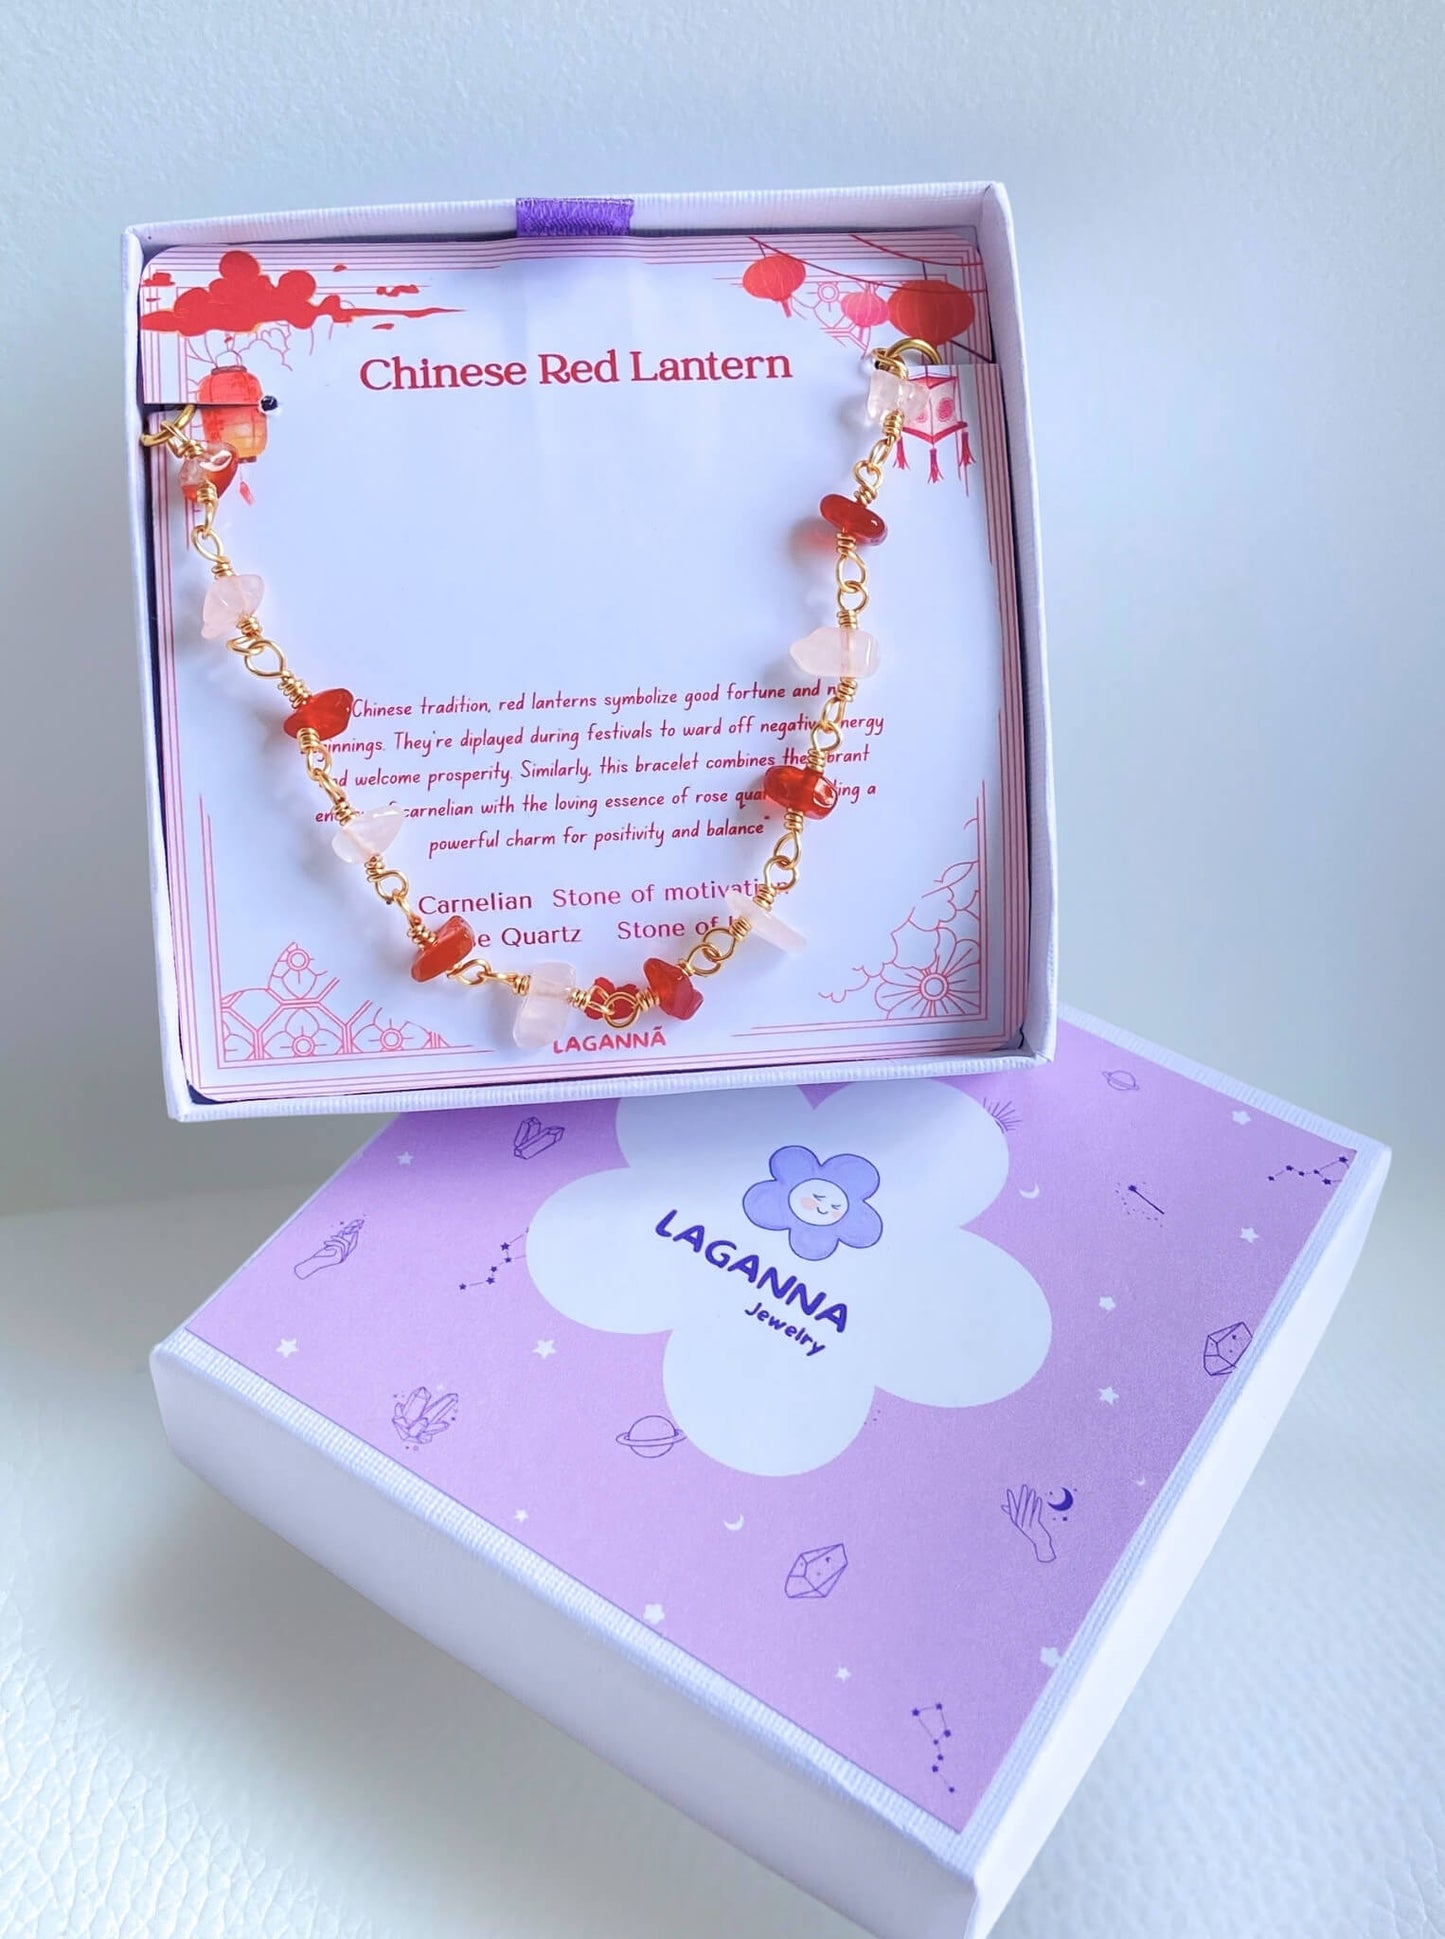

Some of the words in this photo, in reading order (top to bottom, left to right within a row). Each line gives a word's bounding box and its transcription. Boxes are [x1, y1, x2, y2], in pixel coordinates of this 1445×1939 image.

[359, 356, 527, 390] Chinese
[538, 349, 620, 384] Red
[630, 351, 793, 381] Lantern
[352, 699, 412, 718] Chinese
[420, 696, 491, 715] tradition,
[499, 692, 525, 711] red
[531, 690, 597, 709] lanterns
[604, 687, 678, 714] symbolize
[684, 684, 720, 711] good
[726, 681, 786, 701] fortune
[792, 678, 821, 696] and
[394, 730, 453, 757] They're
[460, 726, 524, 754] diplayed
[530, 723, 580, 750] during
[587, 721, 653, 741] festivals
[659, 719, 676, 737] to
[682, 717, 722, 736] ward
[728, 714, 756, 734] off
[760, 713, 819, 740] negativ
[838, 717, 885, 736] nergy
[355, 768, 421, 786] welcome
[520, 758, 592, 784] Similarly,
[600, 756, 629, 774] this
[635, 752, 699, 773] bracelet
[705, 750, 776, 770] combines
[782, 747, 808, 765] the
[481, 797, 515, 815] with
[522, 794, 548, 813] the
[554, 793, 598, 818] loving
[605, 792, 666, 809] essence
[672, 786, 691, 806] of
[695, 792, 729, 804] rose
[867, 785, 877, 796] a
[428, 830, 500, 860] powerful
[505, 830, 556, 849] charm
[563, 826, 588, 846] for
[593, 822, 665, 850] positivity
[671, 819, 700, 839] and
[418, 891, 533, 915] Carnelian
[552, 884, 622, 908] Stone
[630, 883, 656, 903] of
[501, 926, 582, 947] Quartz
[617, 916, 686, 941] Stone
[695, 915, 718, 936] of
[655, 1209, 848, 1333] LAGANNA
[744, 1302, 826, 1357] Jewelry
